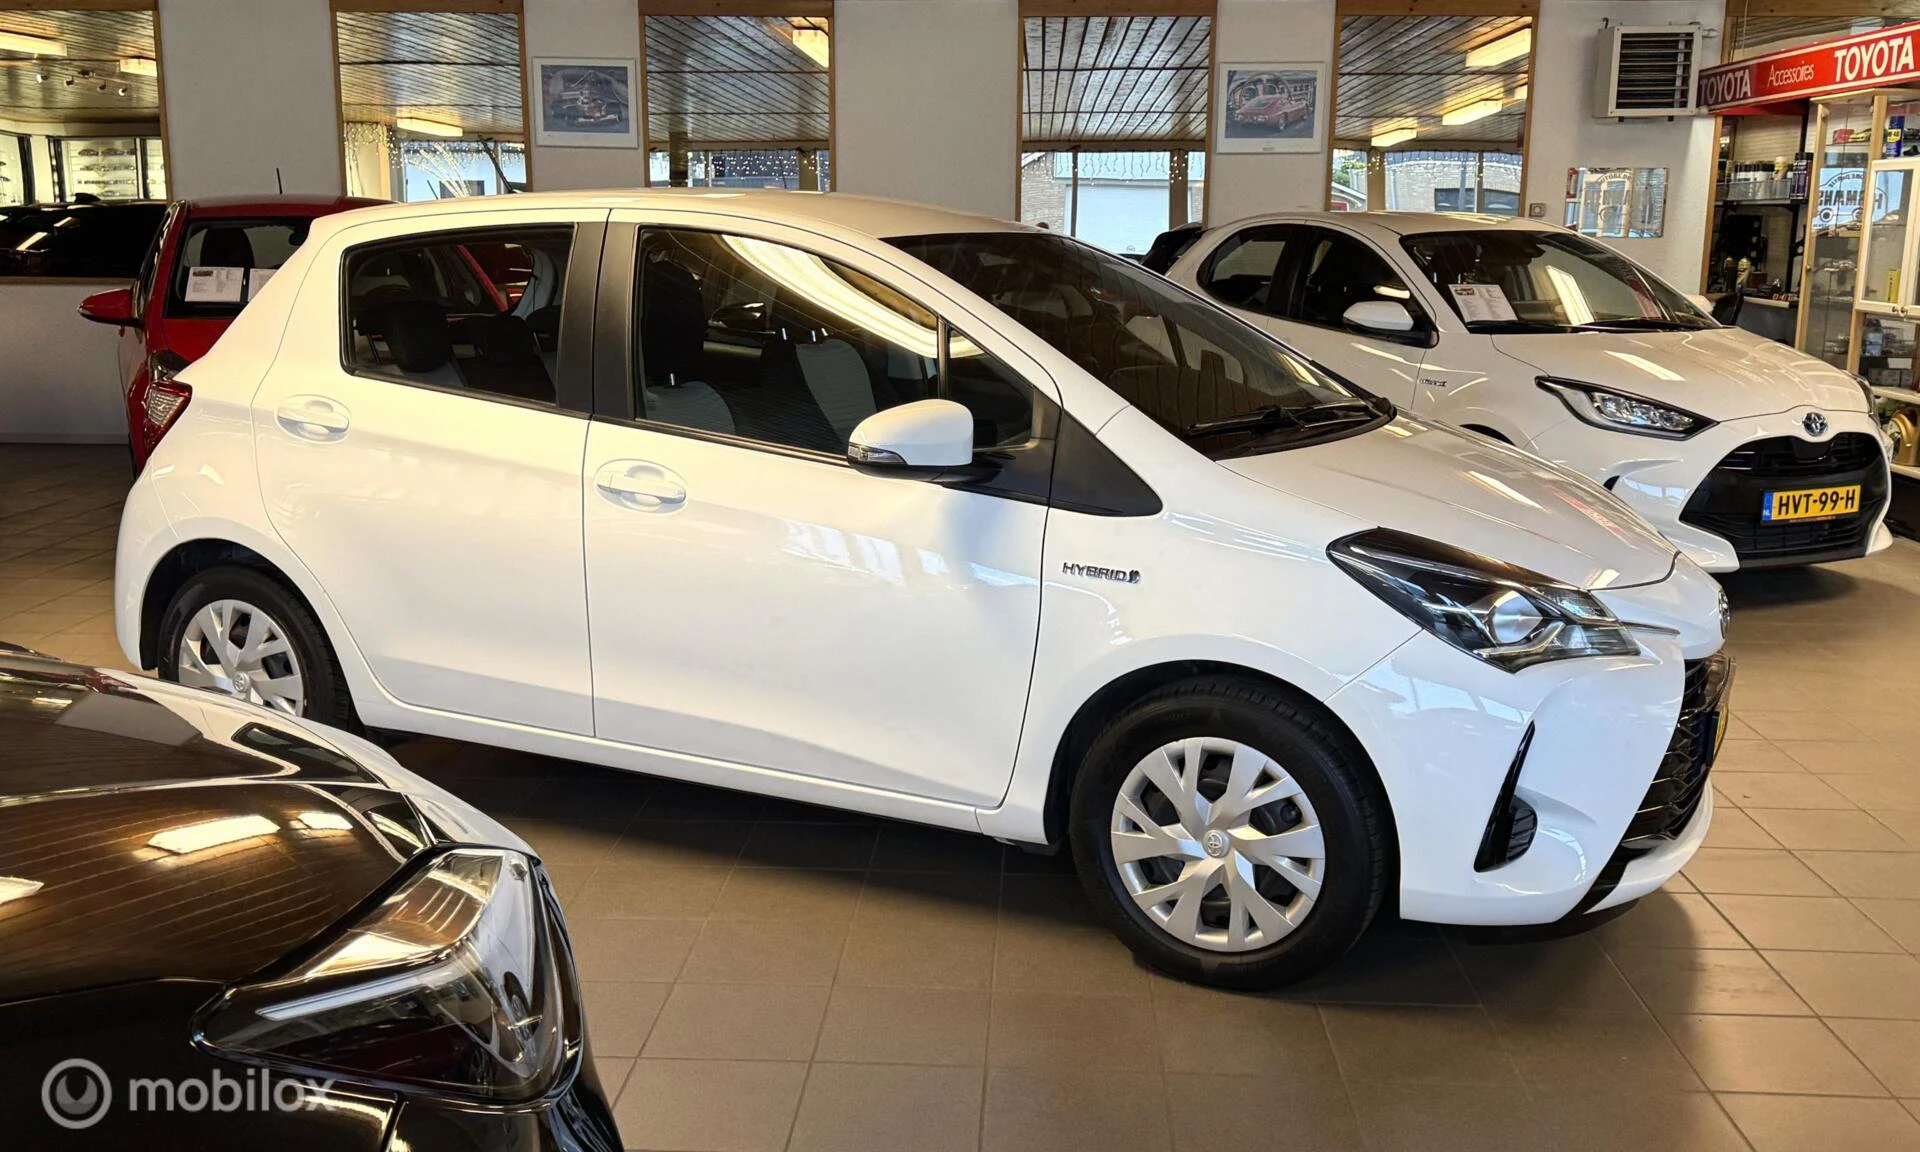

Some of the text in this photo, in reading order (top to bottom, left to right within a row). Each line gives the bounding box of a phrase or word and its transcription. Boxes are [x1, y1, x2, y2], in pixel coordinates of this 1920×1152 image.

[1700, 35, 1914, 106] TOYOTA Accessoires TOYOTA
[1778, 489, 1856, 516] HVT-99-H
[1062, 562, 1127, 582] HYBRID
